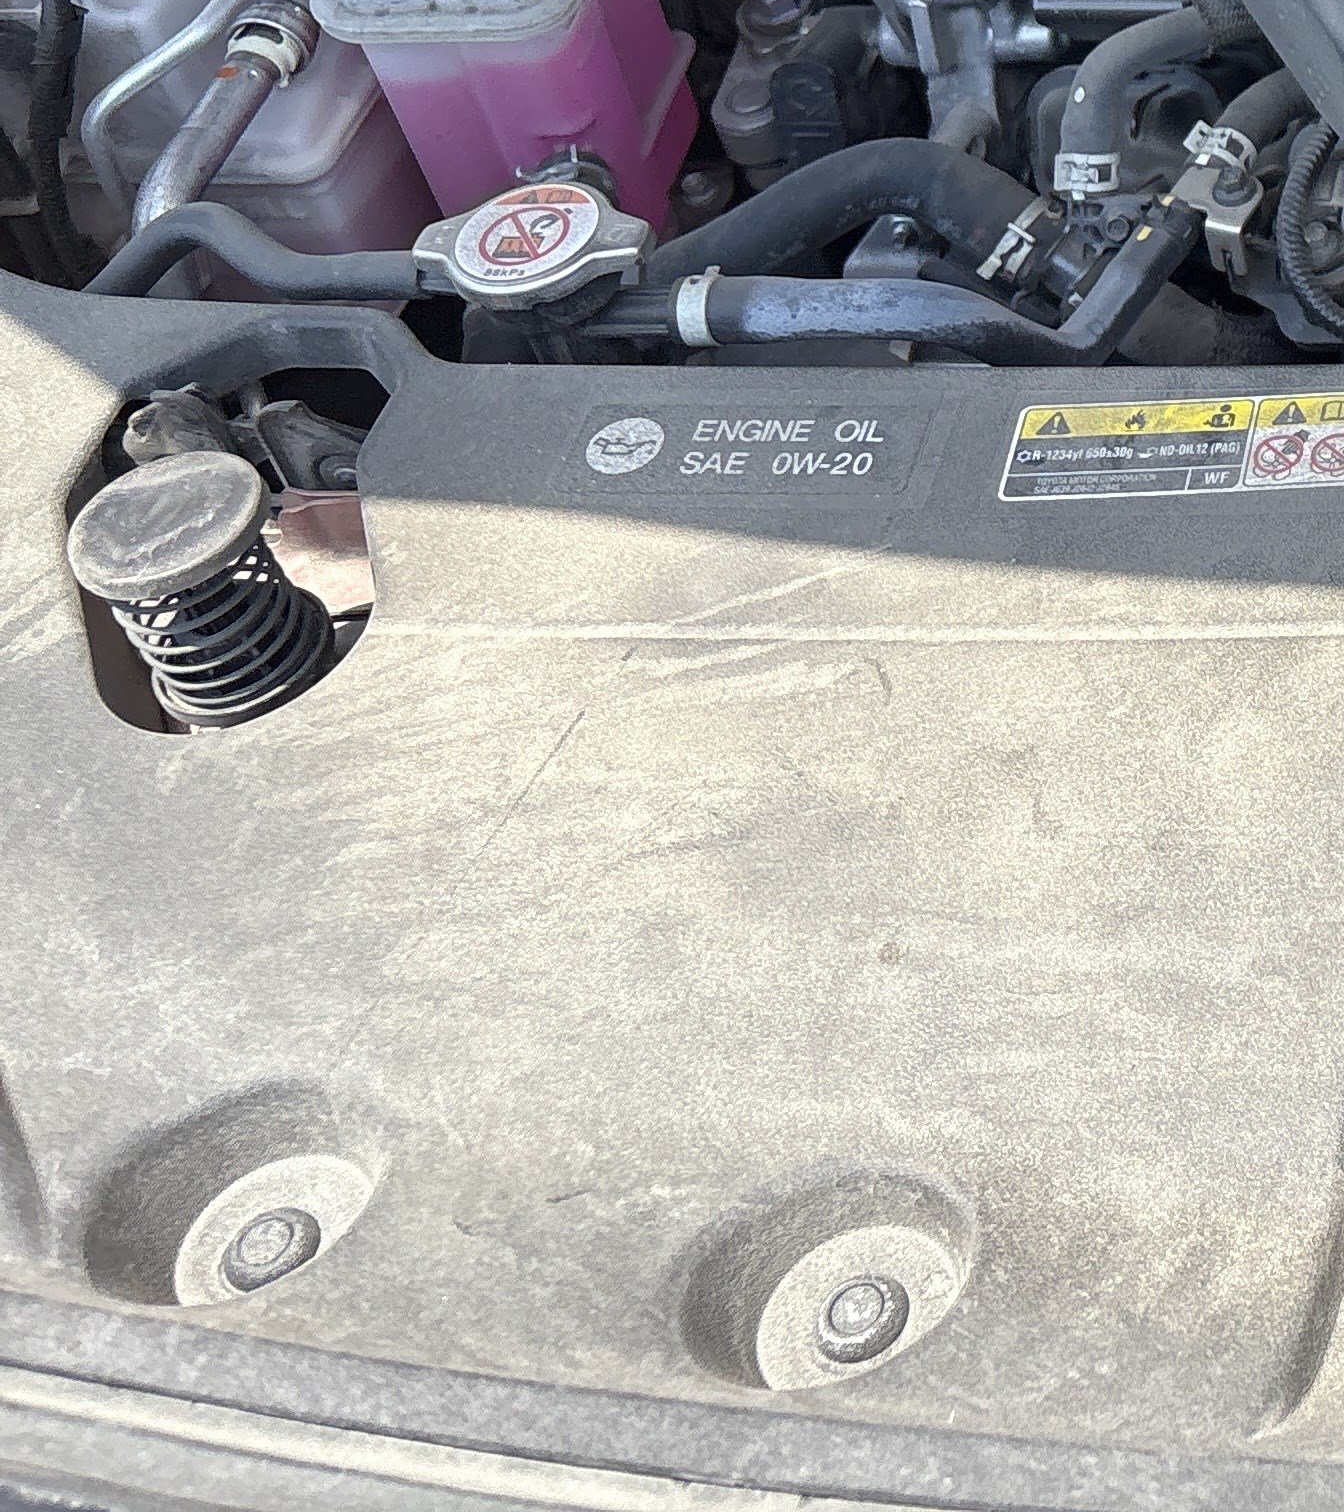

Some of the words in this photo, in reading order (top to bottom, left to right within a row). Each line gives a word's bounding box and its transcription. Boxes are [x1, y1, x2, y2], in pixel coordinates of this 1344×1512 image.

[692, 419, 816, 443] ENGINE
[834, 419, 885, 443] OIL
[679, 451, 750, 475] SAE
[771, 451, 874, 475] 0W-20
[1204, 471, 1231, 486] WF
